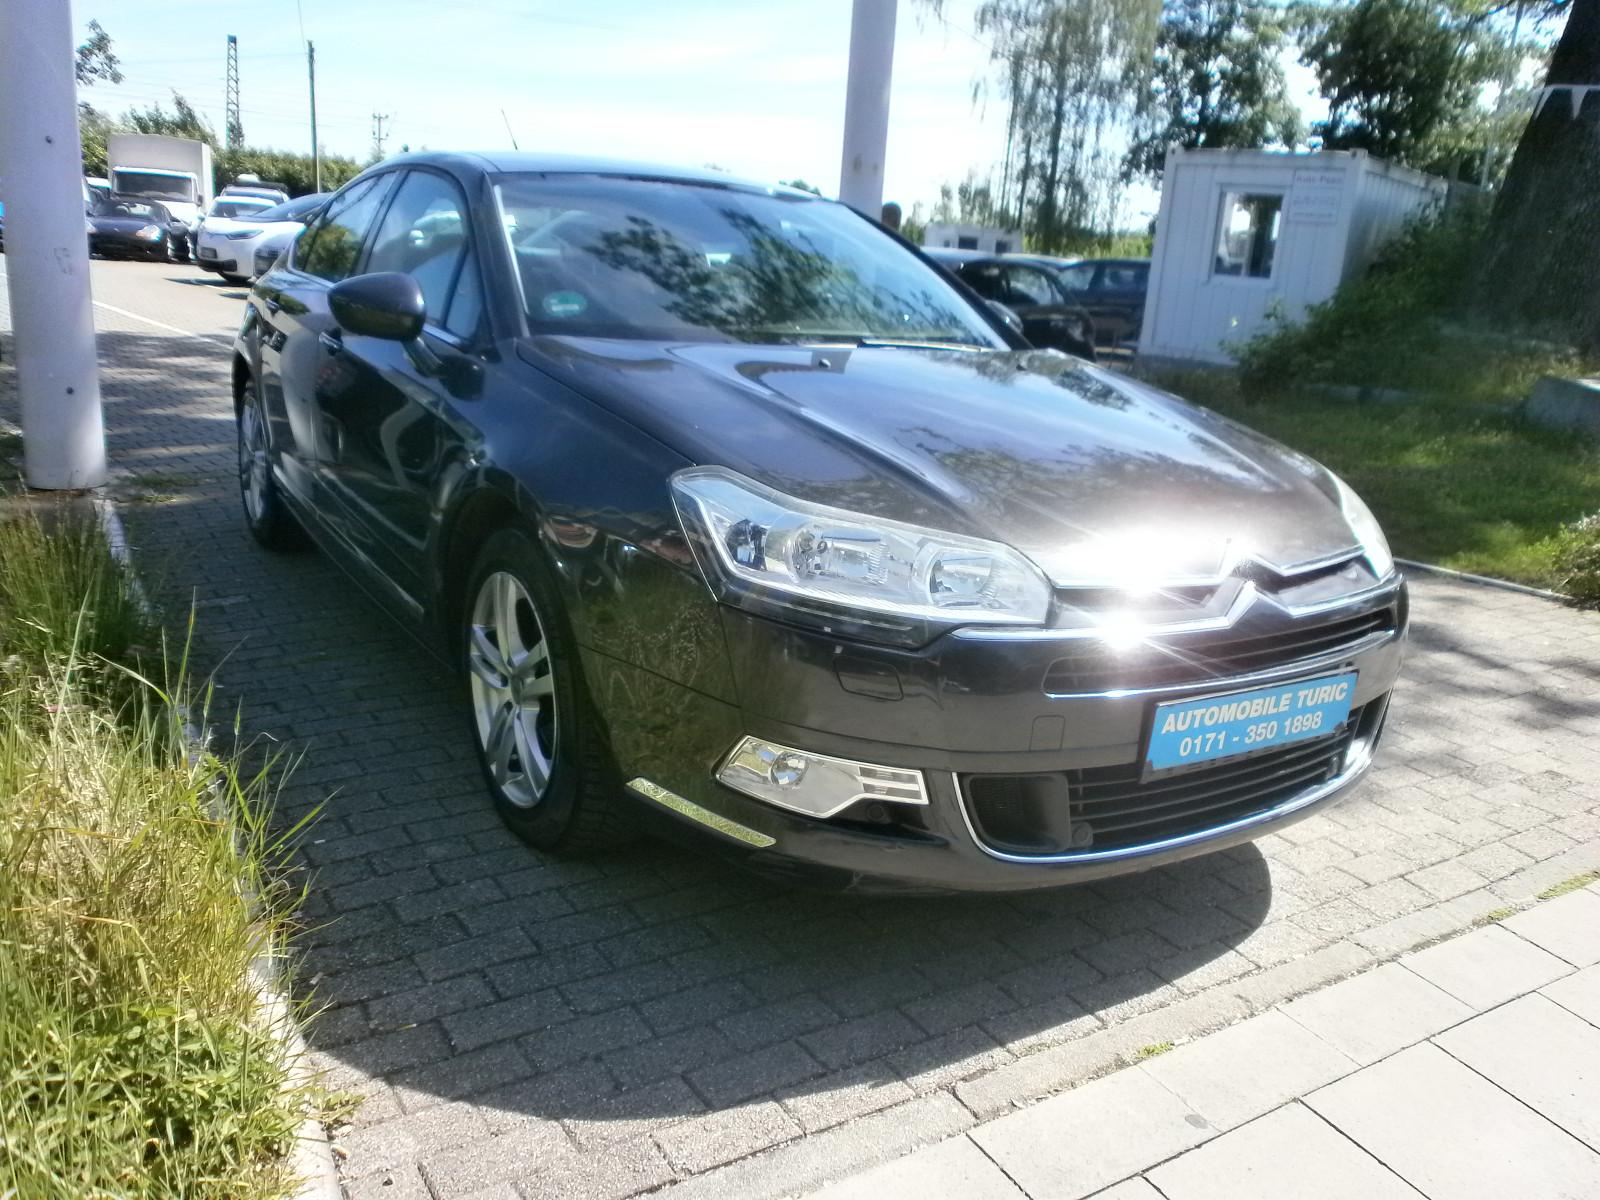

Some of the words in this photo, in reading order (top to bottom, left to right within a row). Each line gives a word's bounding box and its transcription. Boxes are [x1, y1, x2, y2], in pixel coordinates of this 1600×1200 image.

[1161, 693, 1291, 734] AUTOMOBILE
[1297, 682, 1348, 709] TURIC
[1179, 731, 1227, 757] 0171
[1244, 720, 1277, 744] 350
[1284, 711, 1322, 736] 1898
